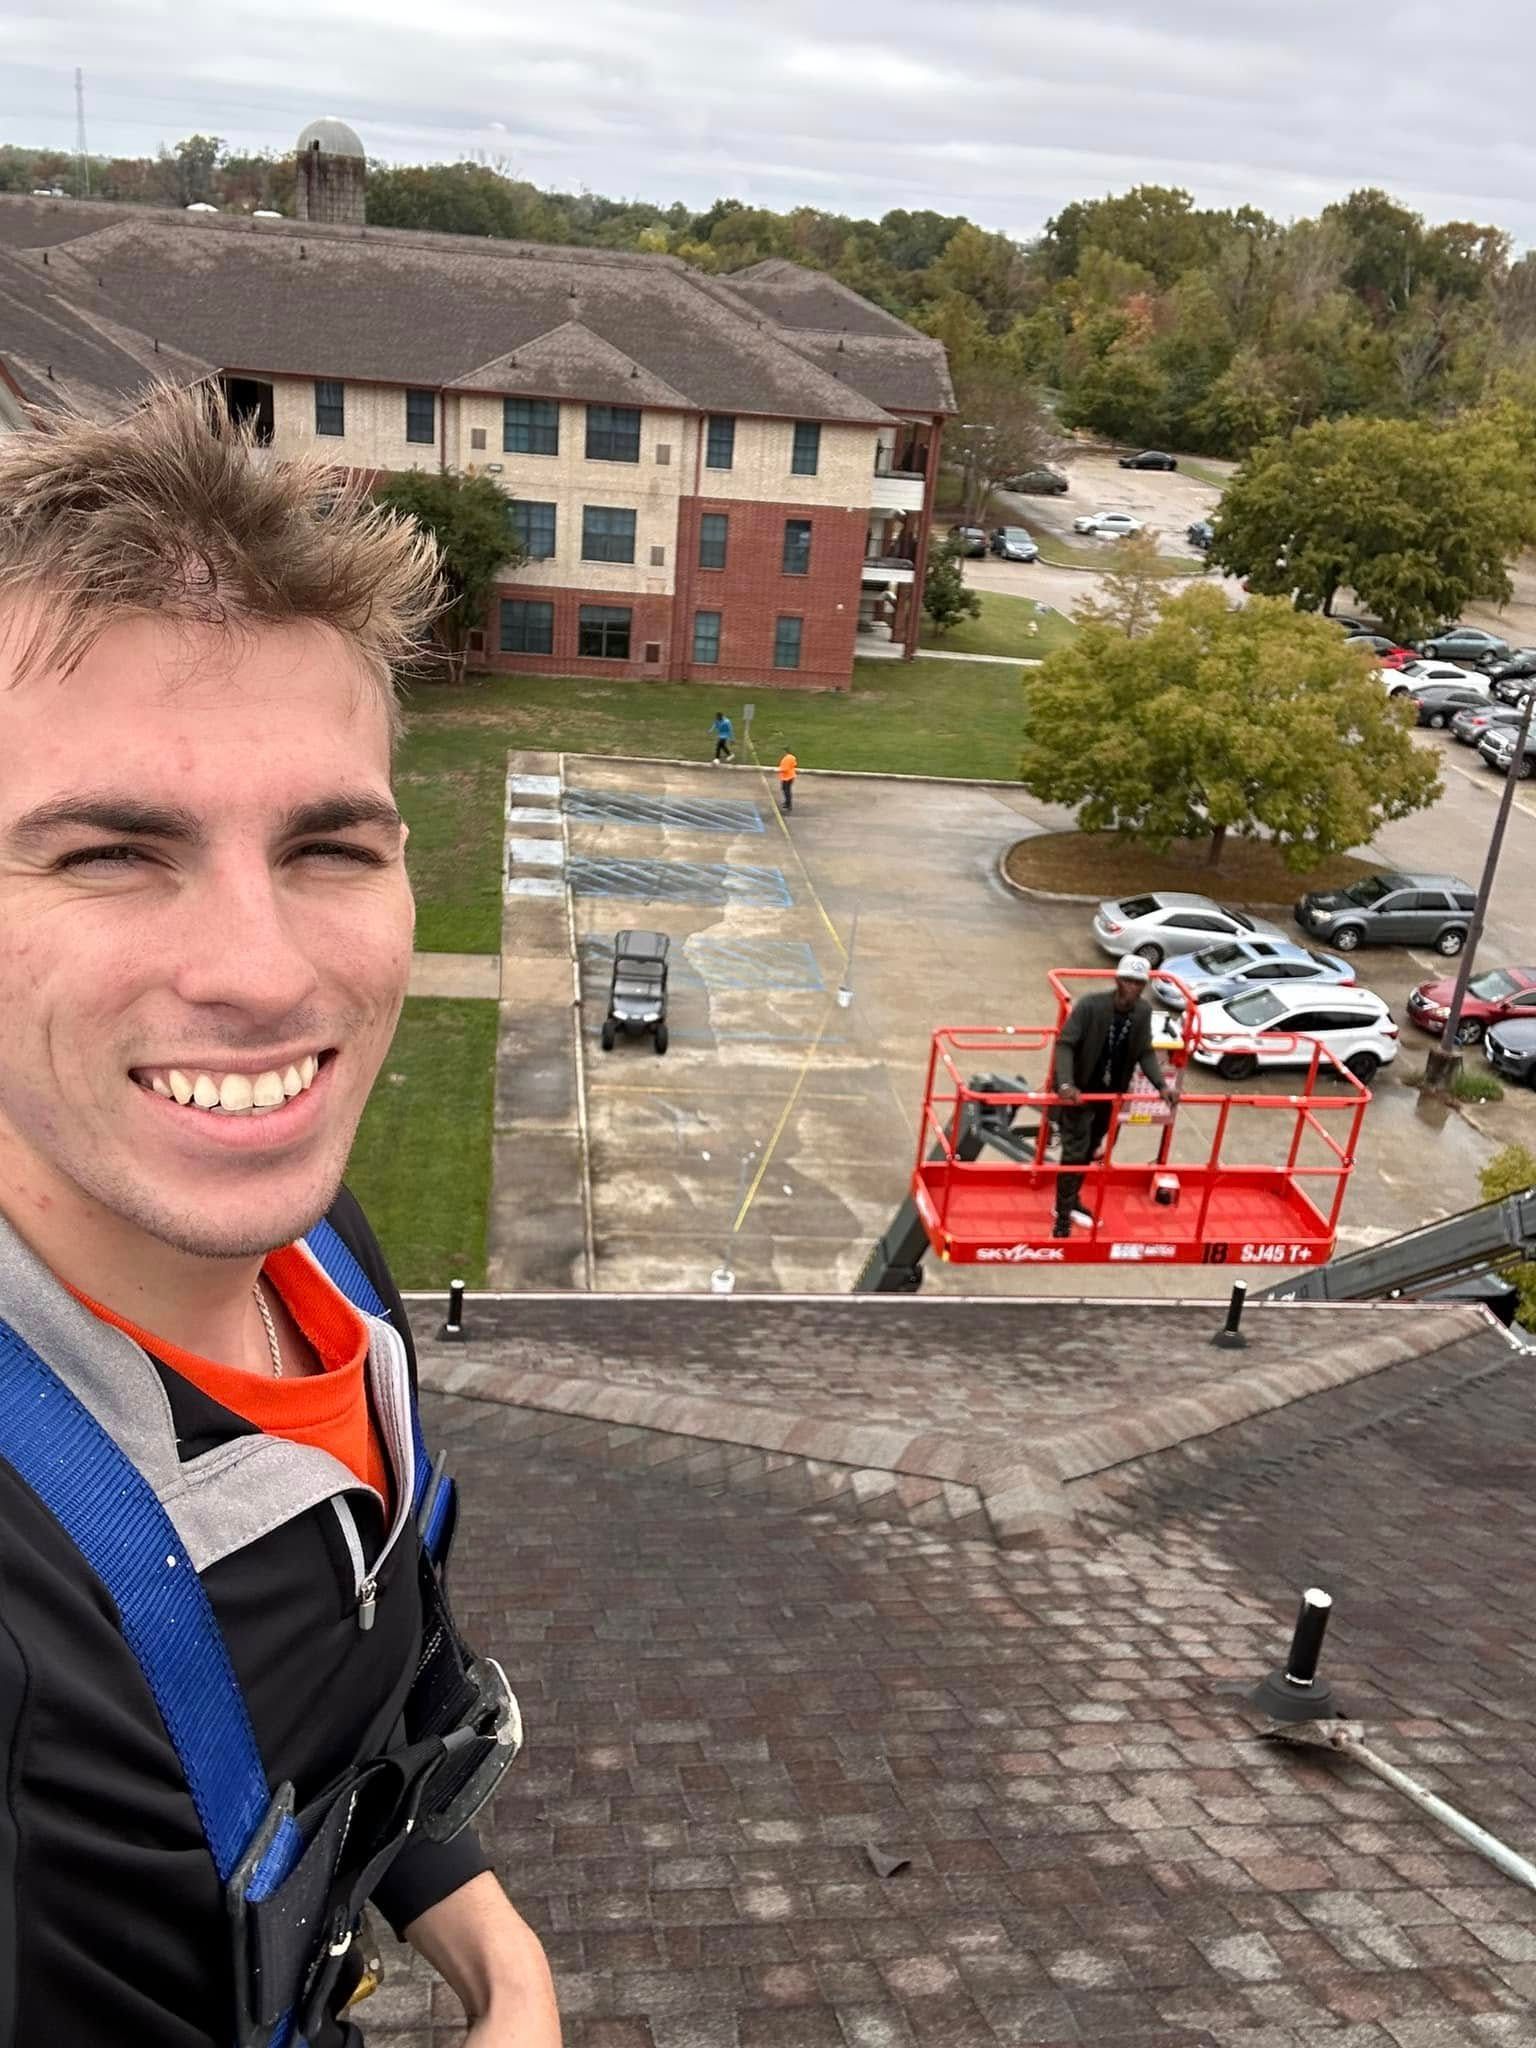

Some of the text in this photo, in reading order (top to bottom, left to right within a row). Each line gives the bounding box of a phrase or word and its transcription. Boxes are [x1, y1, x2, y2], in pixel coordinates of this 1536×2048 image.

[976, 1243, 1064, 1261] SKYJACK
[1202, 1243, 1228, 1264] 18
[1241, 1244, 1312, 1262] SJ45 T+
